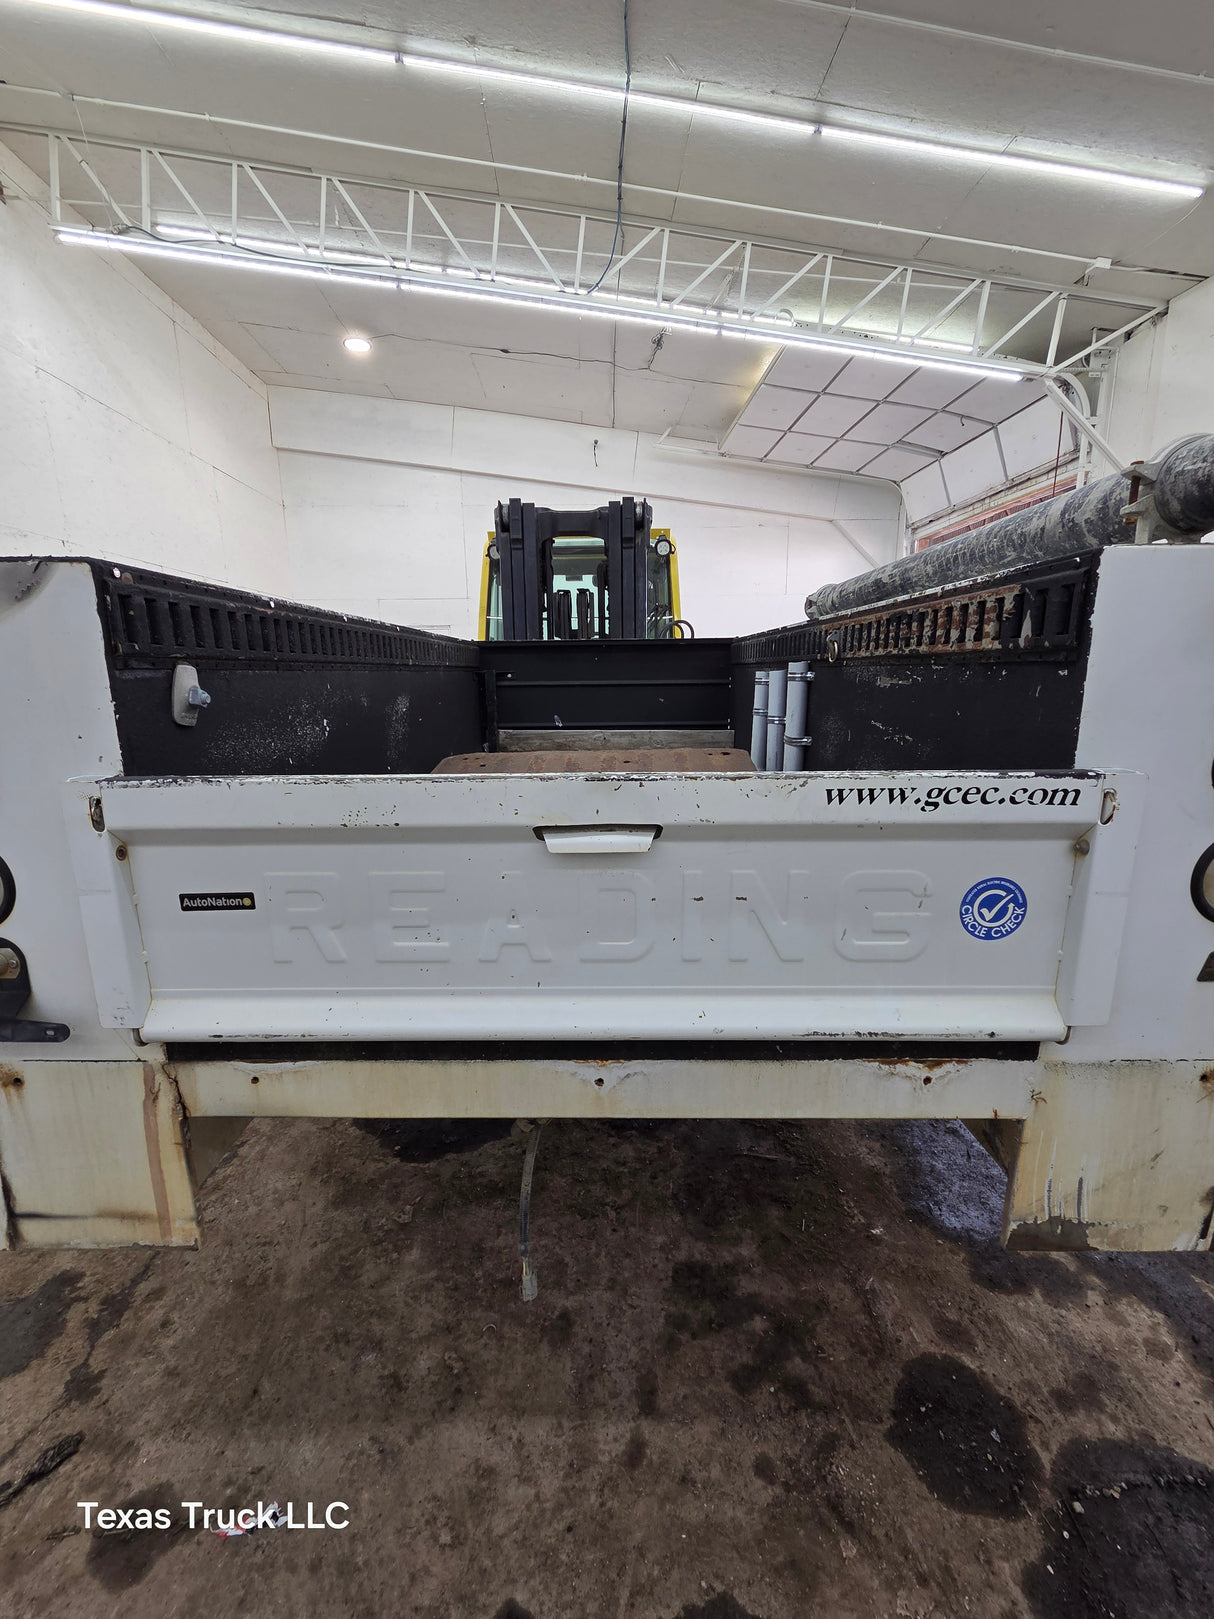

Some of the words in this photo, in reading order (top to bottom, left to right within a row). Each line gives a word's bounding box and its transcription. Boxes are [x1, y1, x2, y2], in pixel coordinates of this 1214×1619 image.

[825, 786, 1081, 812] www.gcec.com
[183, 897, 243, 907] AutoNation
[263, 870, 933, 963] READING
[962, 905, 988, 937] CIRCLE
[991, 907, 1025, 937] CHECK
